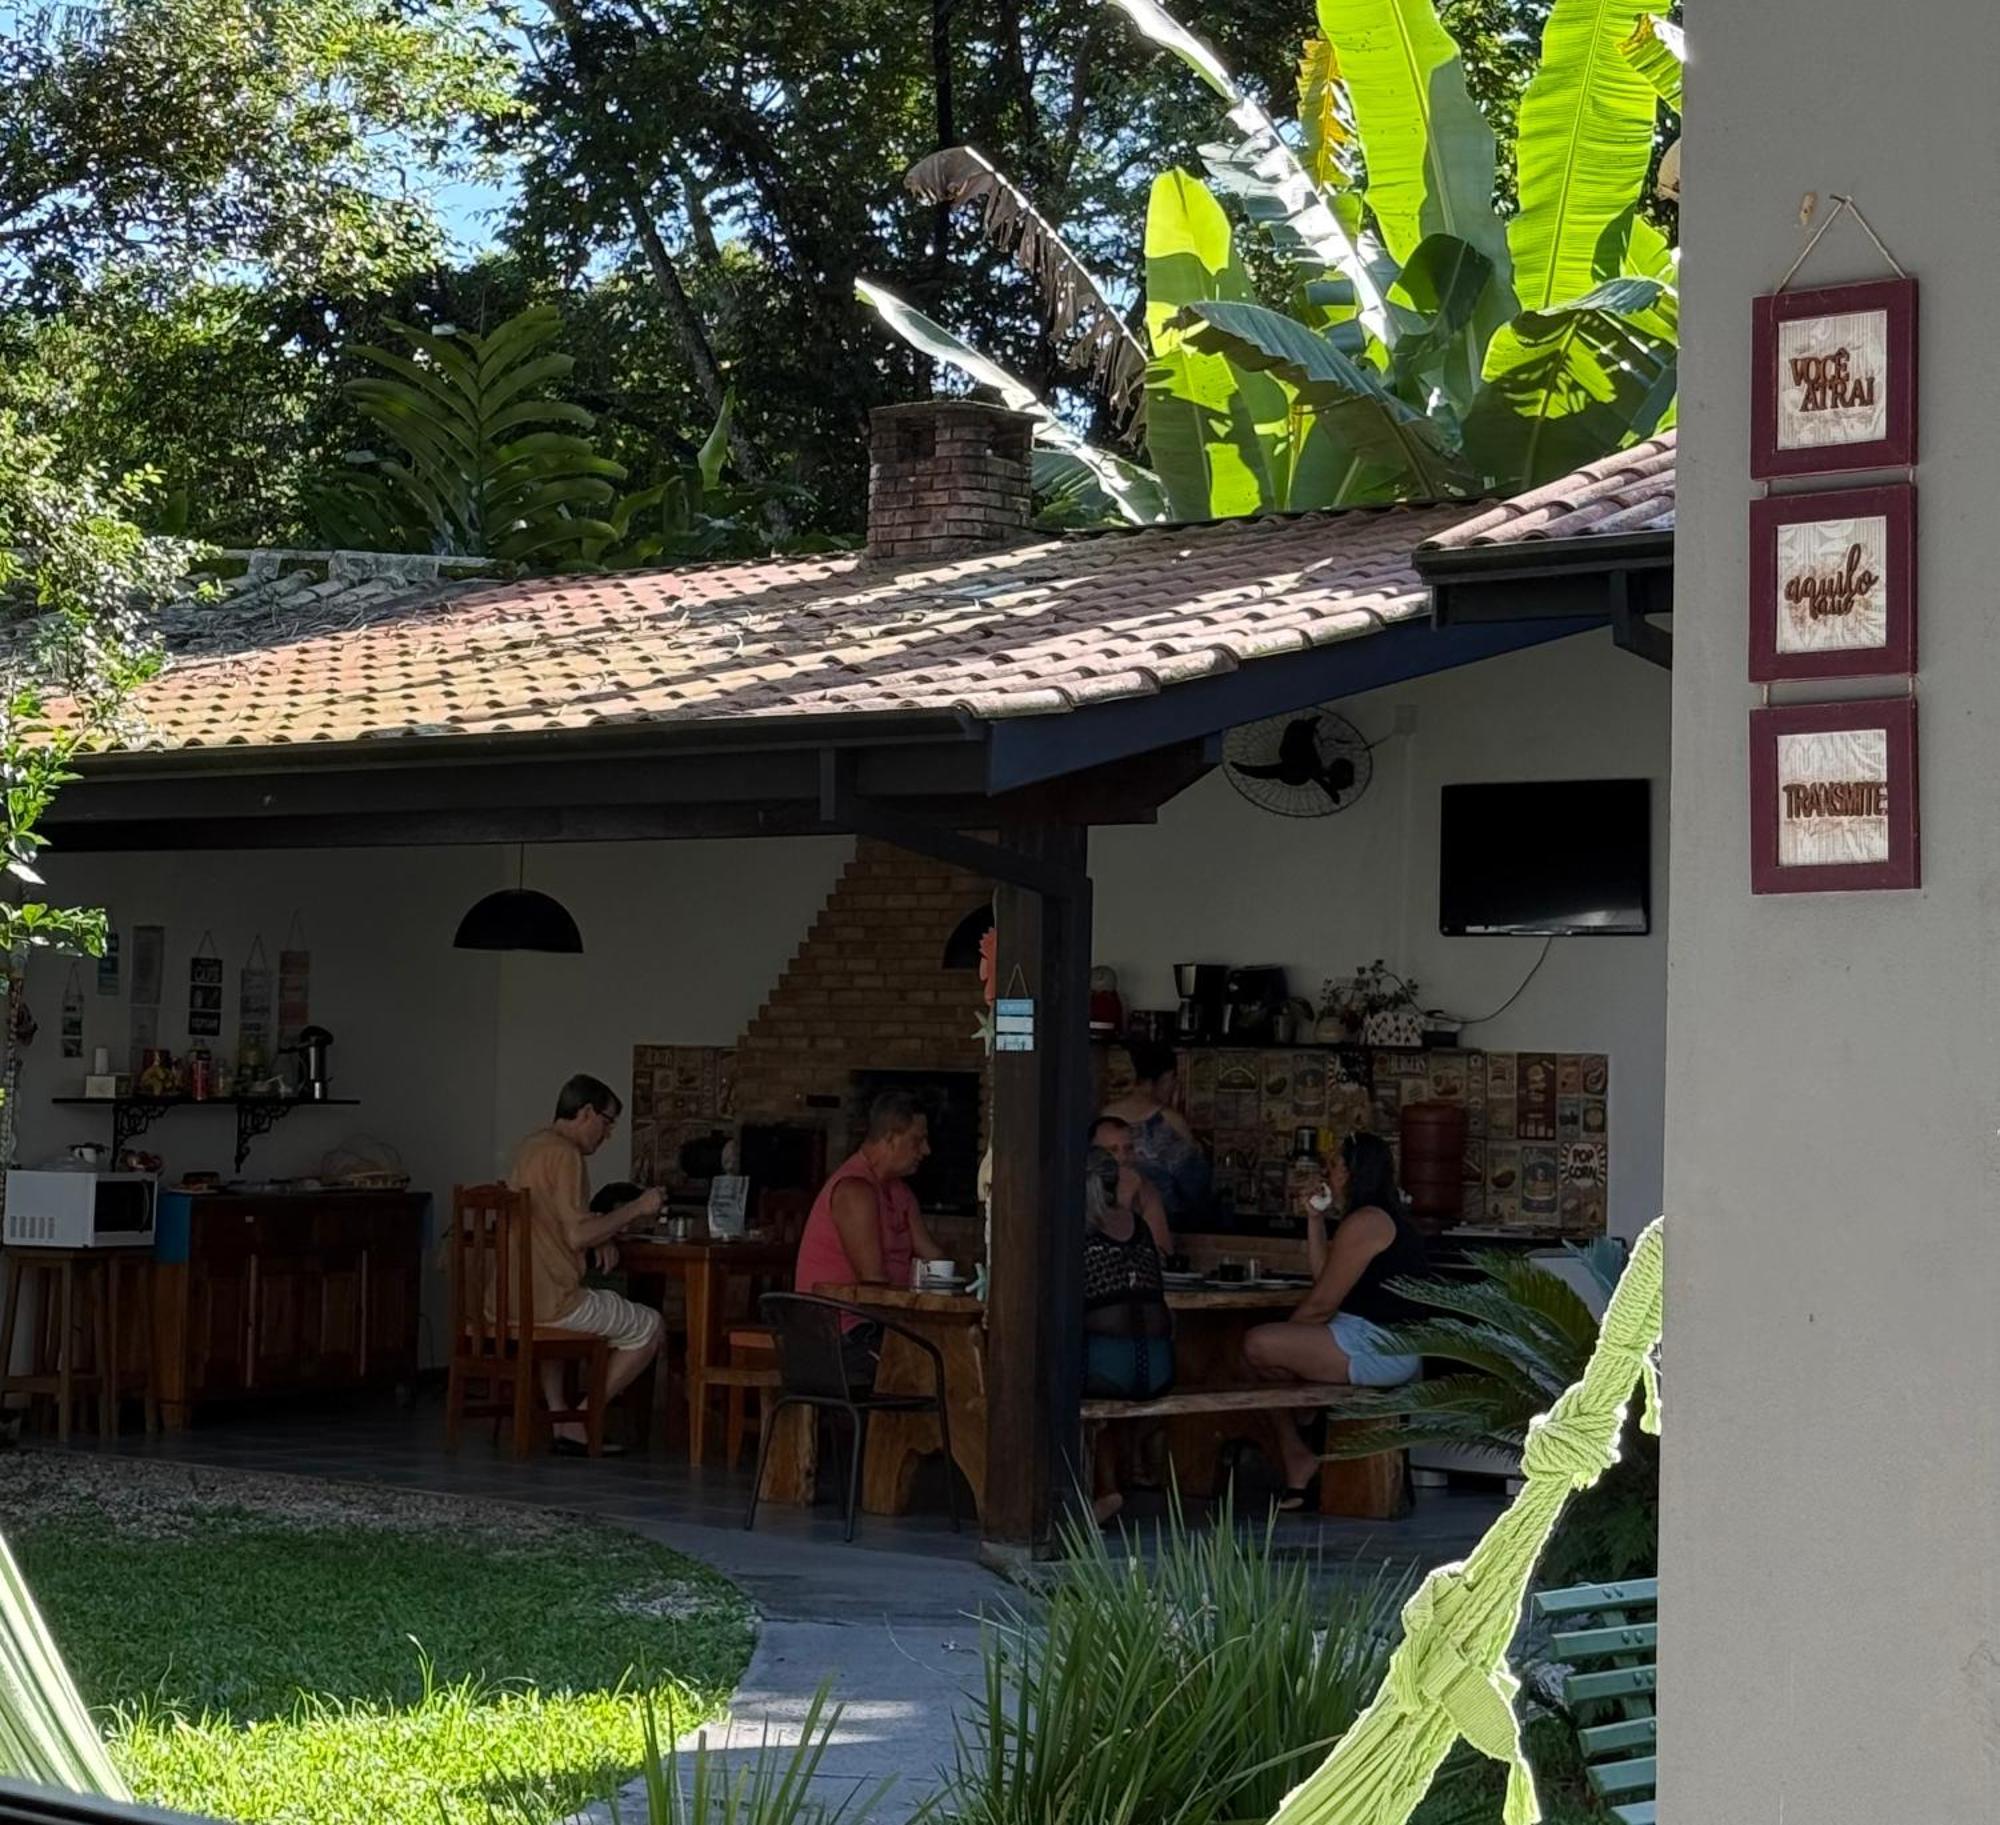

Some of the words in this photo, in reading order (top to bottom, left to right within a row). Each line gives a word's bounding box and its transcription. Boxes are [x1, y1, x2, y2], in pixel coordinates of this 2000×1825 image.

[1789, 347, 1850, 386] VOCÊ
[1799, 376, 1875, 412] ATRAI
[1784, 543, 1879, 620] aquilo
[1783, 781, 1888, 819] TRANSMITE
[1569, 1165, 1597, 1179] CORN
[1573, 1149, 1594, 1163] POP
